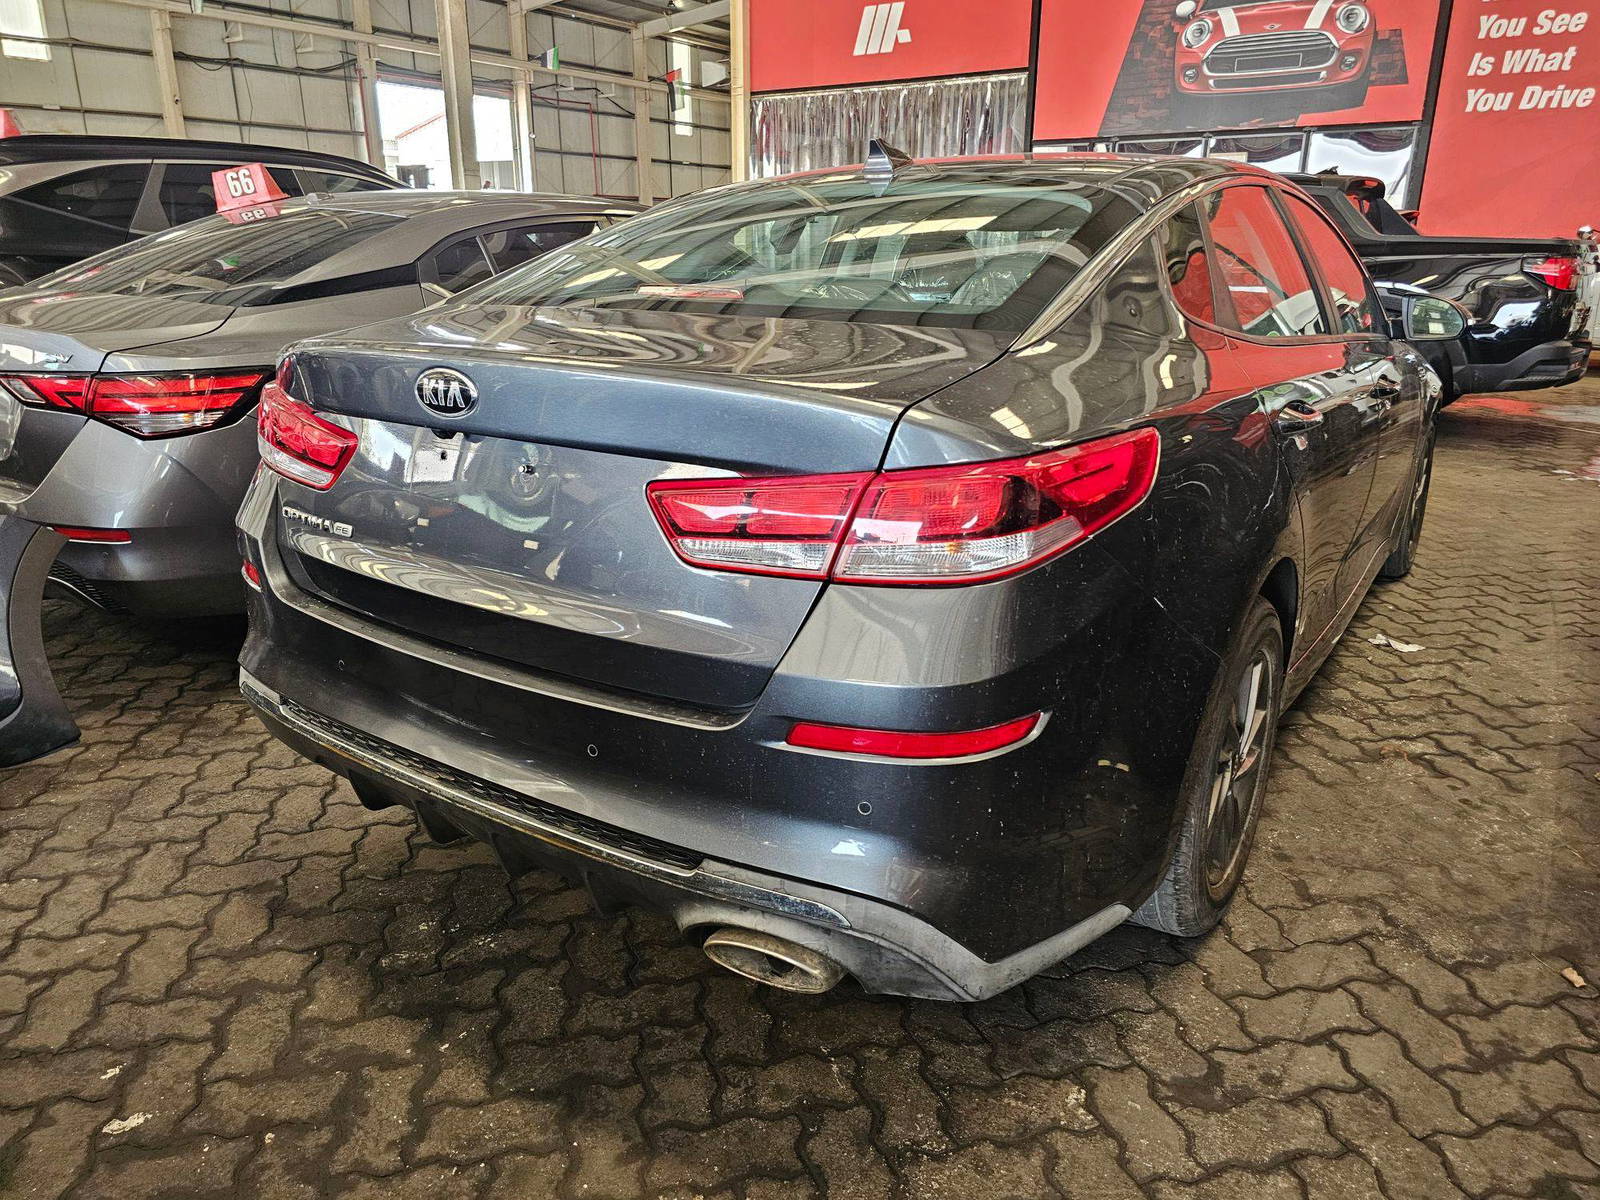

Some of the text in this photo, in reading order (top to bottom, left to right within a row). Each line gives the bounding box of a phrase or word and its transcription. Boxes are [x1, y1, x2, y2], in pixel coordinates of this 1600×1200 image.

[1477, 9, 1588, 39] You See
[1467, 46, 1577, 76] Is What
[1465, 84, 1596, 112] You Drive
[225, 168, 255, 197] 66
[422, 377, 466, 408] KIA
